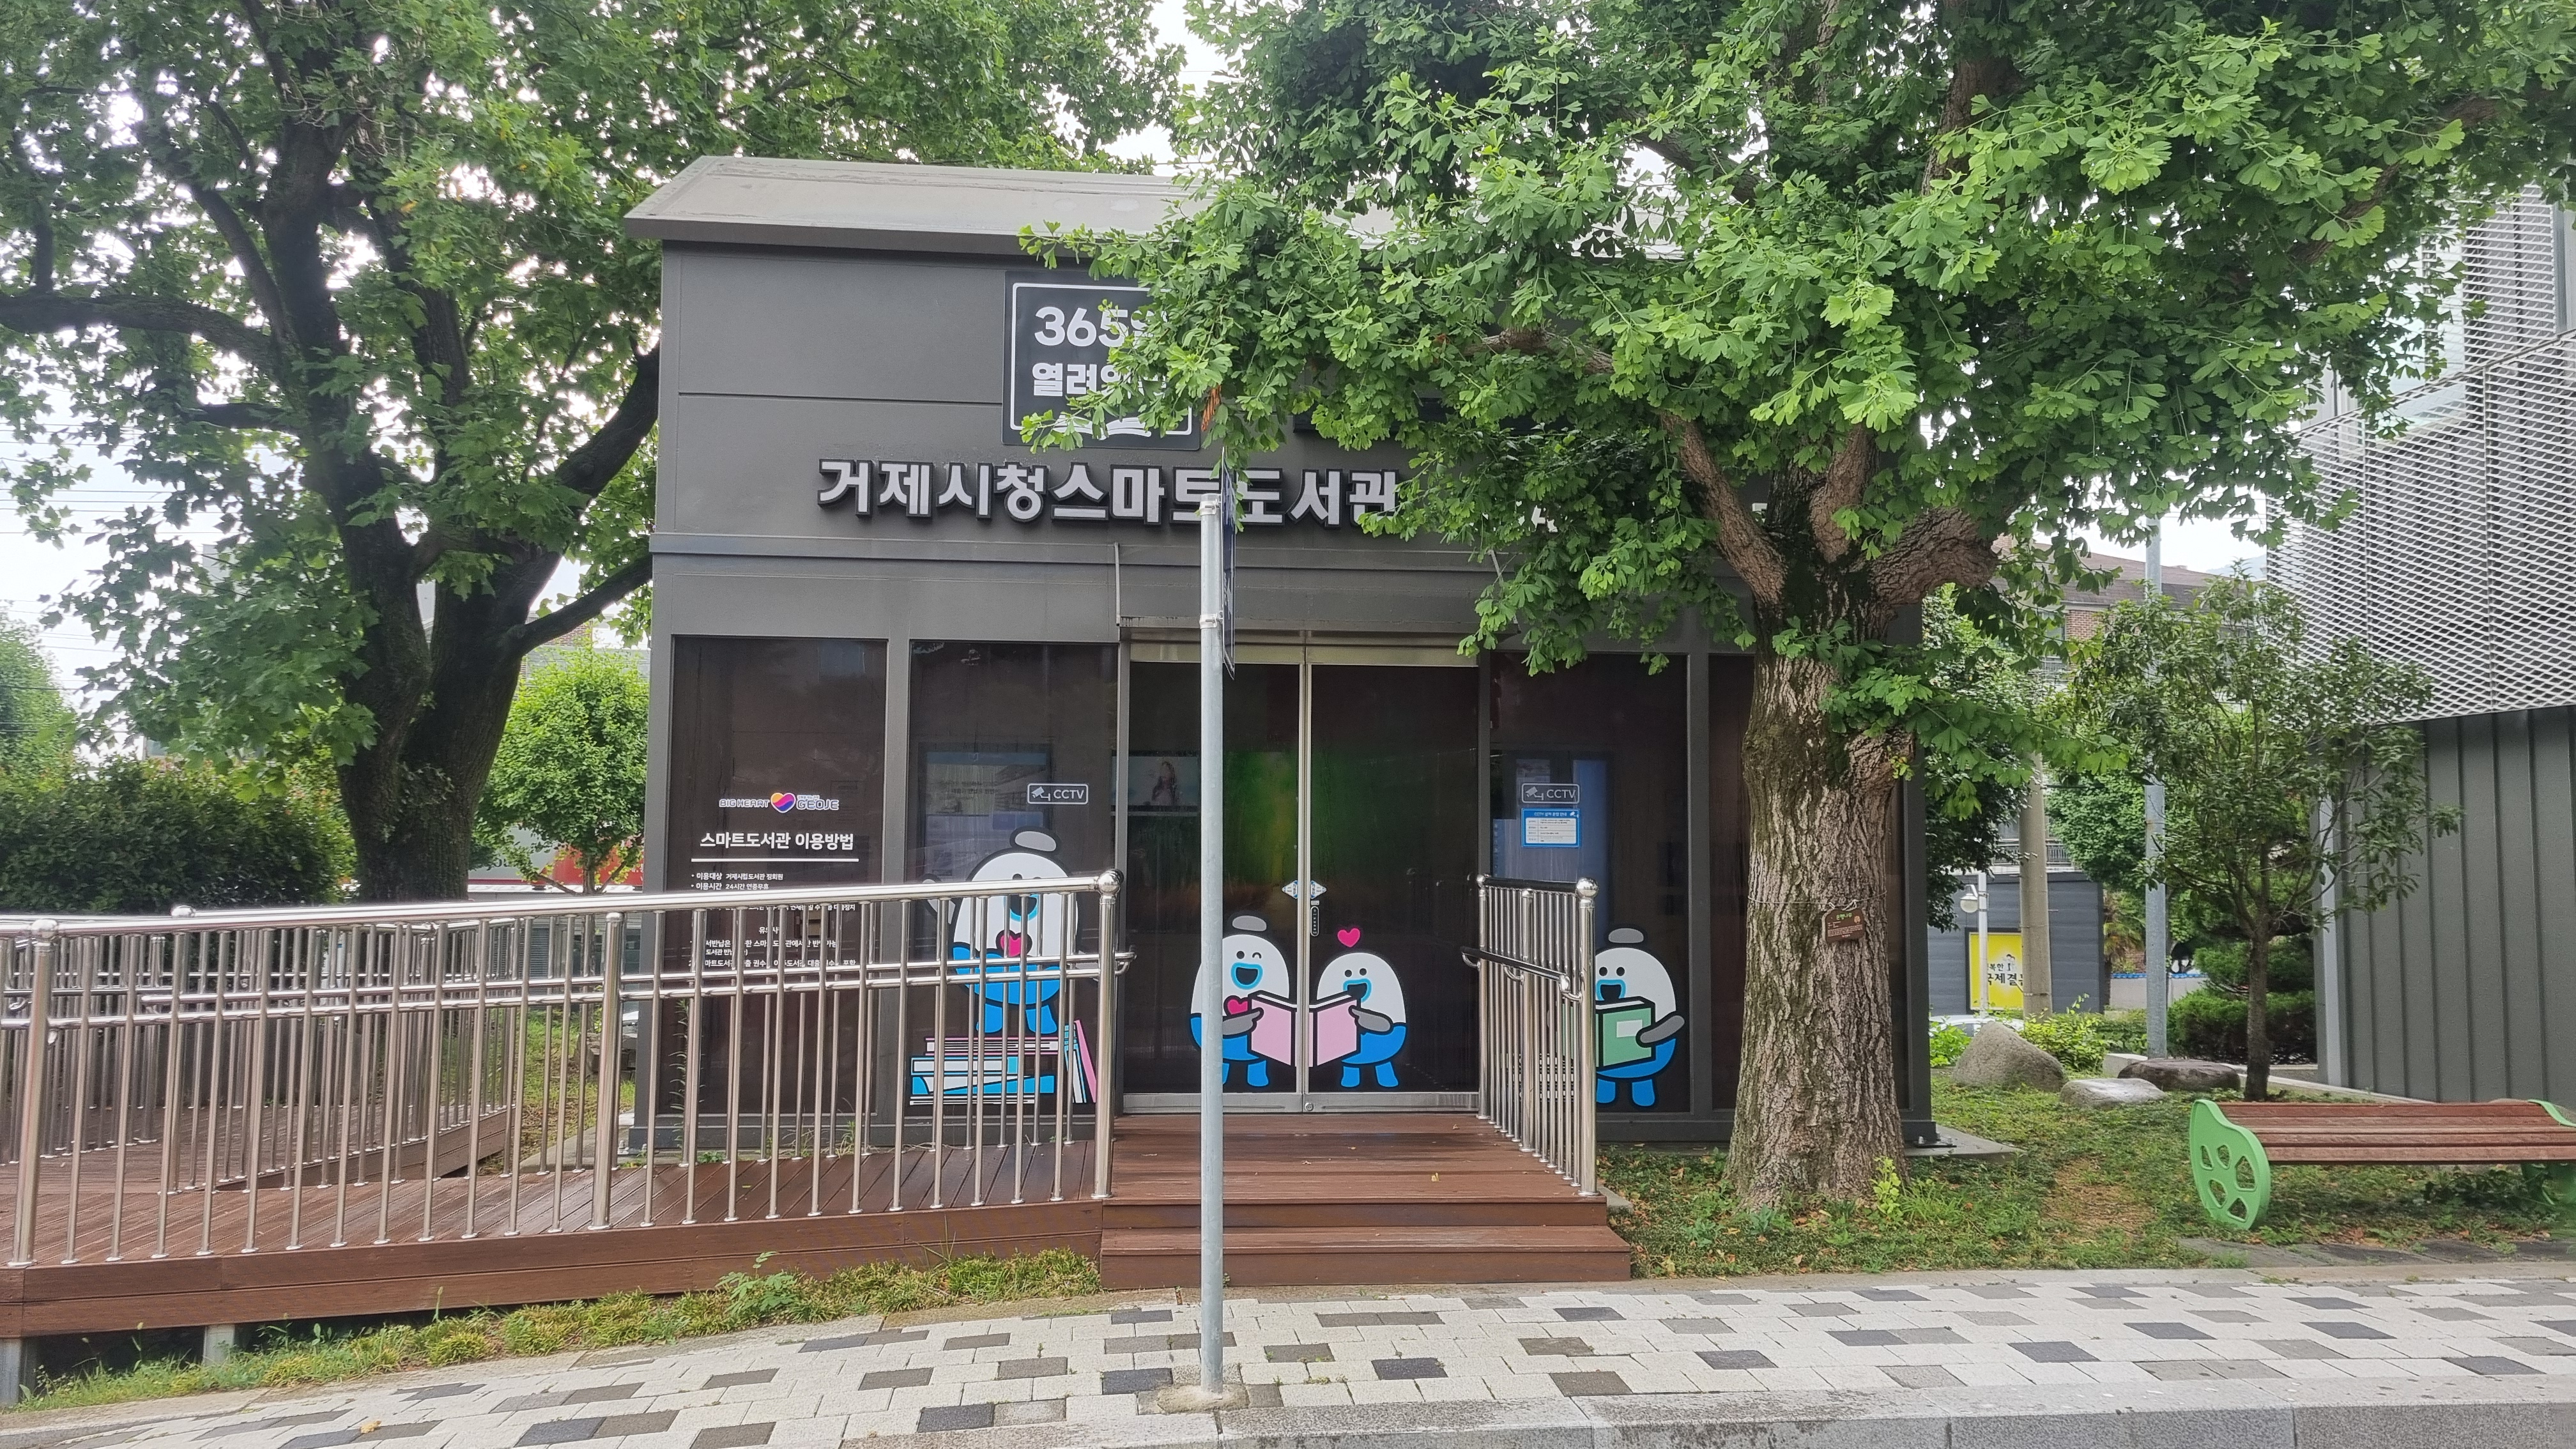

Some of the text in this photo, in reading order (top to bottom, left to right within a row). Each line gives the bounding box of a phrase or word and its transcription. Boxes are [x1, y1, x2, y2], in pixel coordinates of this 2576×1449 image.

[1032, 362, 1167, 399] 열려
[1053, 789, 1084, 799] CCTV
[1546, 789, 1576, 799] CCTV
[719, 799, 839, 811] BIG HEART GEOJE
[700, 832, 854, 850] 스마트도서관 이용방법
[696, 872, 723, 880] 이용대상
[696, 882, 722, 891] 이용시간
[1988, 963, 2004, 972] 복한
